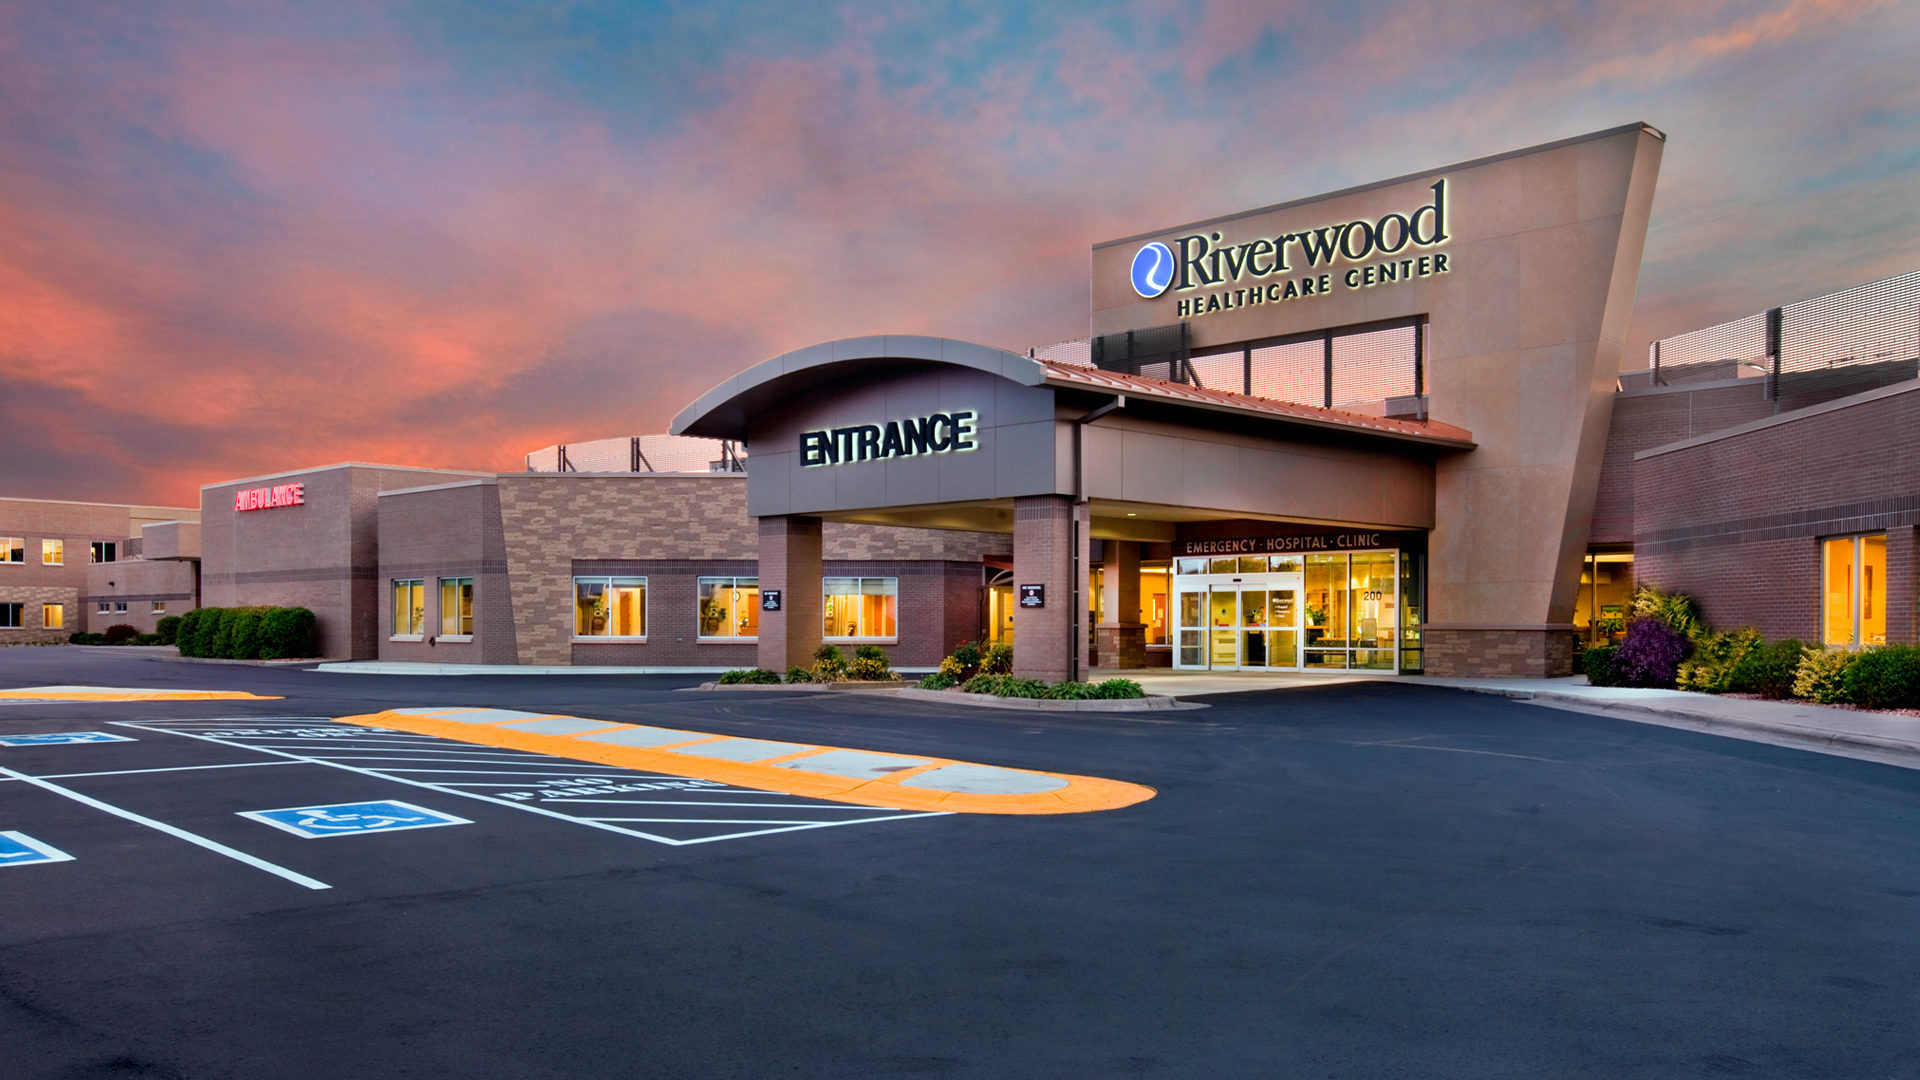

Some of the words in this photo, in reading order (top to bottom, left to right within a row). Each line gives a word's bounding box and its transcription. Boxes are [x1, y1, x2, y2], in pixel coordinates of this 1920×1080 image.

[1175, 179, 1448, 291] Riverwood
[1177, 274, 1330, 317] HEALTHCARE
[1344, 253, 1449, 288] CENTER
[800, 411, 976, 467] ENTRANCE
[234, 482, 304, 512] AMBULANCE
[1186, 539, 1256, 554] EMERGENCY
[1266, 536, 1327, 550] HOSPITAL
[1337, 533, 1380, 547] CLINIC
[1363, 591, 1382, 601] 200
[494, 780, 728, 801] PARKING
[536, 778, 613, 788] NO
